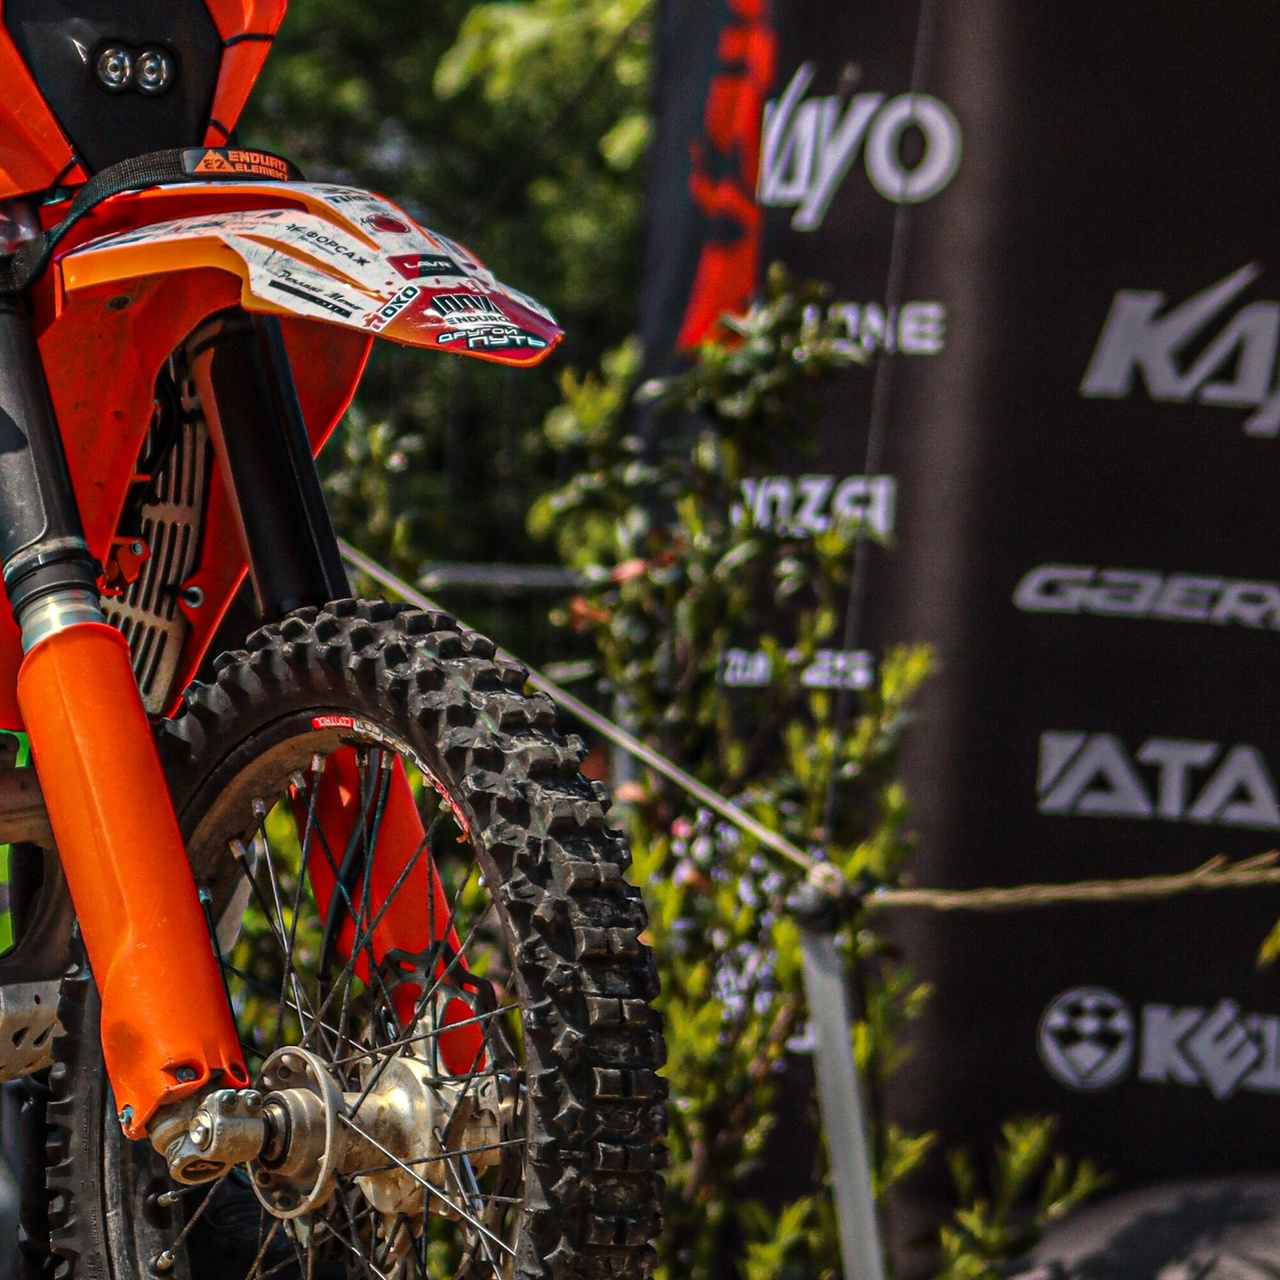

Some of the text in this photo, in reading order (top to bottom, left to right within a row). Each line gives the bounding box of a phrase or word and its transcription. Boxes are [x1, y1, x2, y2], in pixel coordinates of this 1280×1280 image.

[228, 150, 287, 173] ENDURO
[235, 162, 290, 181] ELEMENT
[306, 230, 371, 266] ФОРСАЖ
[402, 260, 452, 269] LAVR
[446, 315, 509, 326] ENDURO
[439, 326, 518, 343] ДРУГОЙ
[468, 334, 547, 348] ПУТЬ
[1075, 260, 1280, 440] KA
[315, 716, 352, 727] CONTROL
